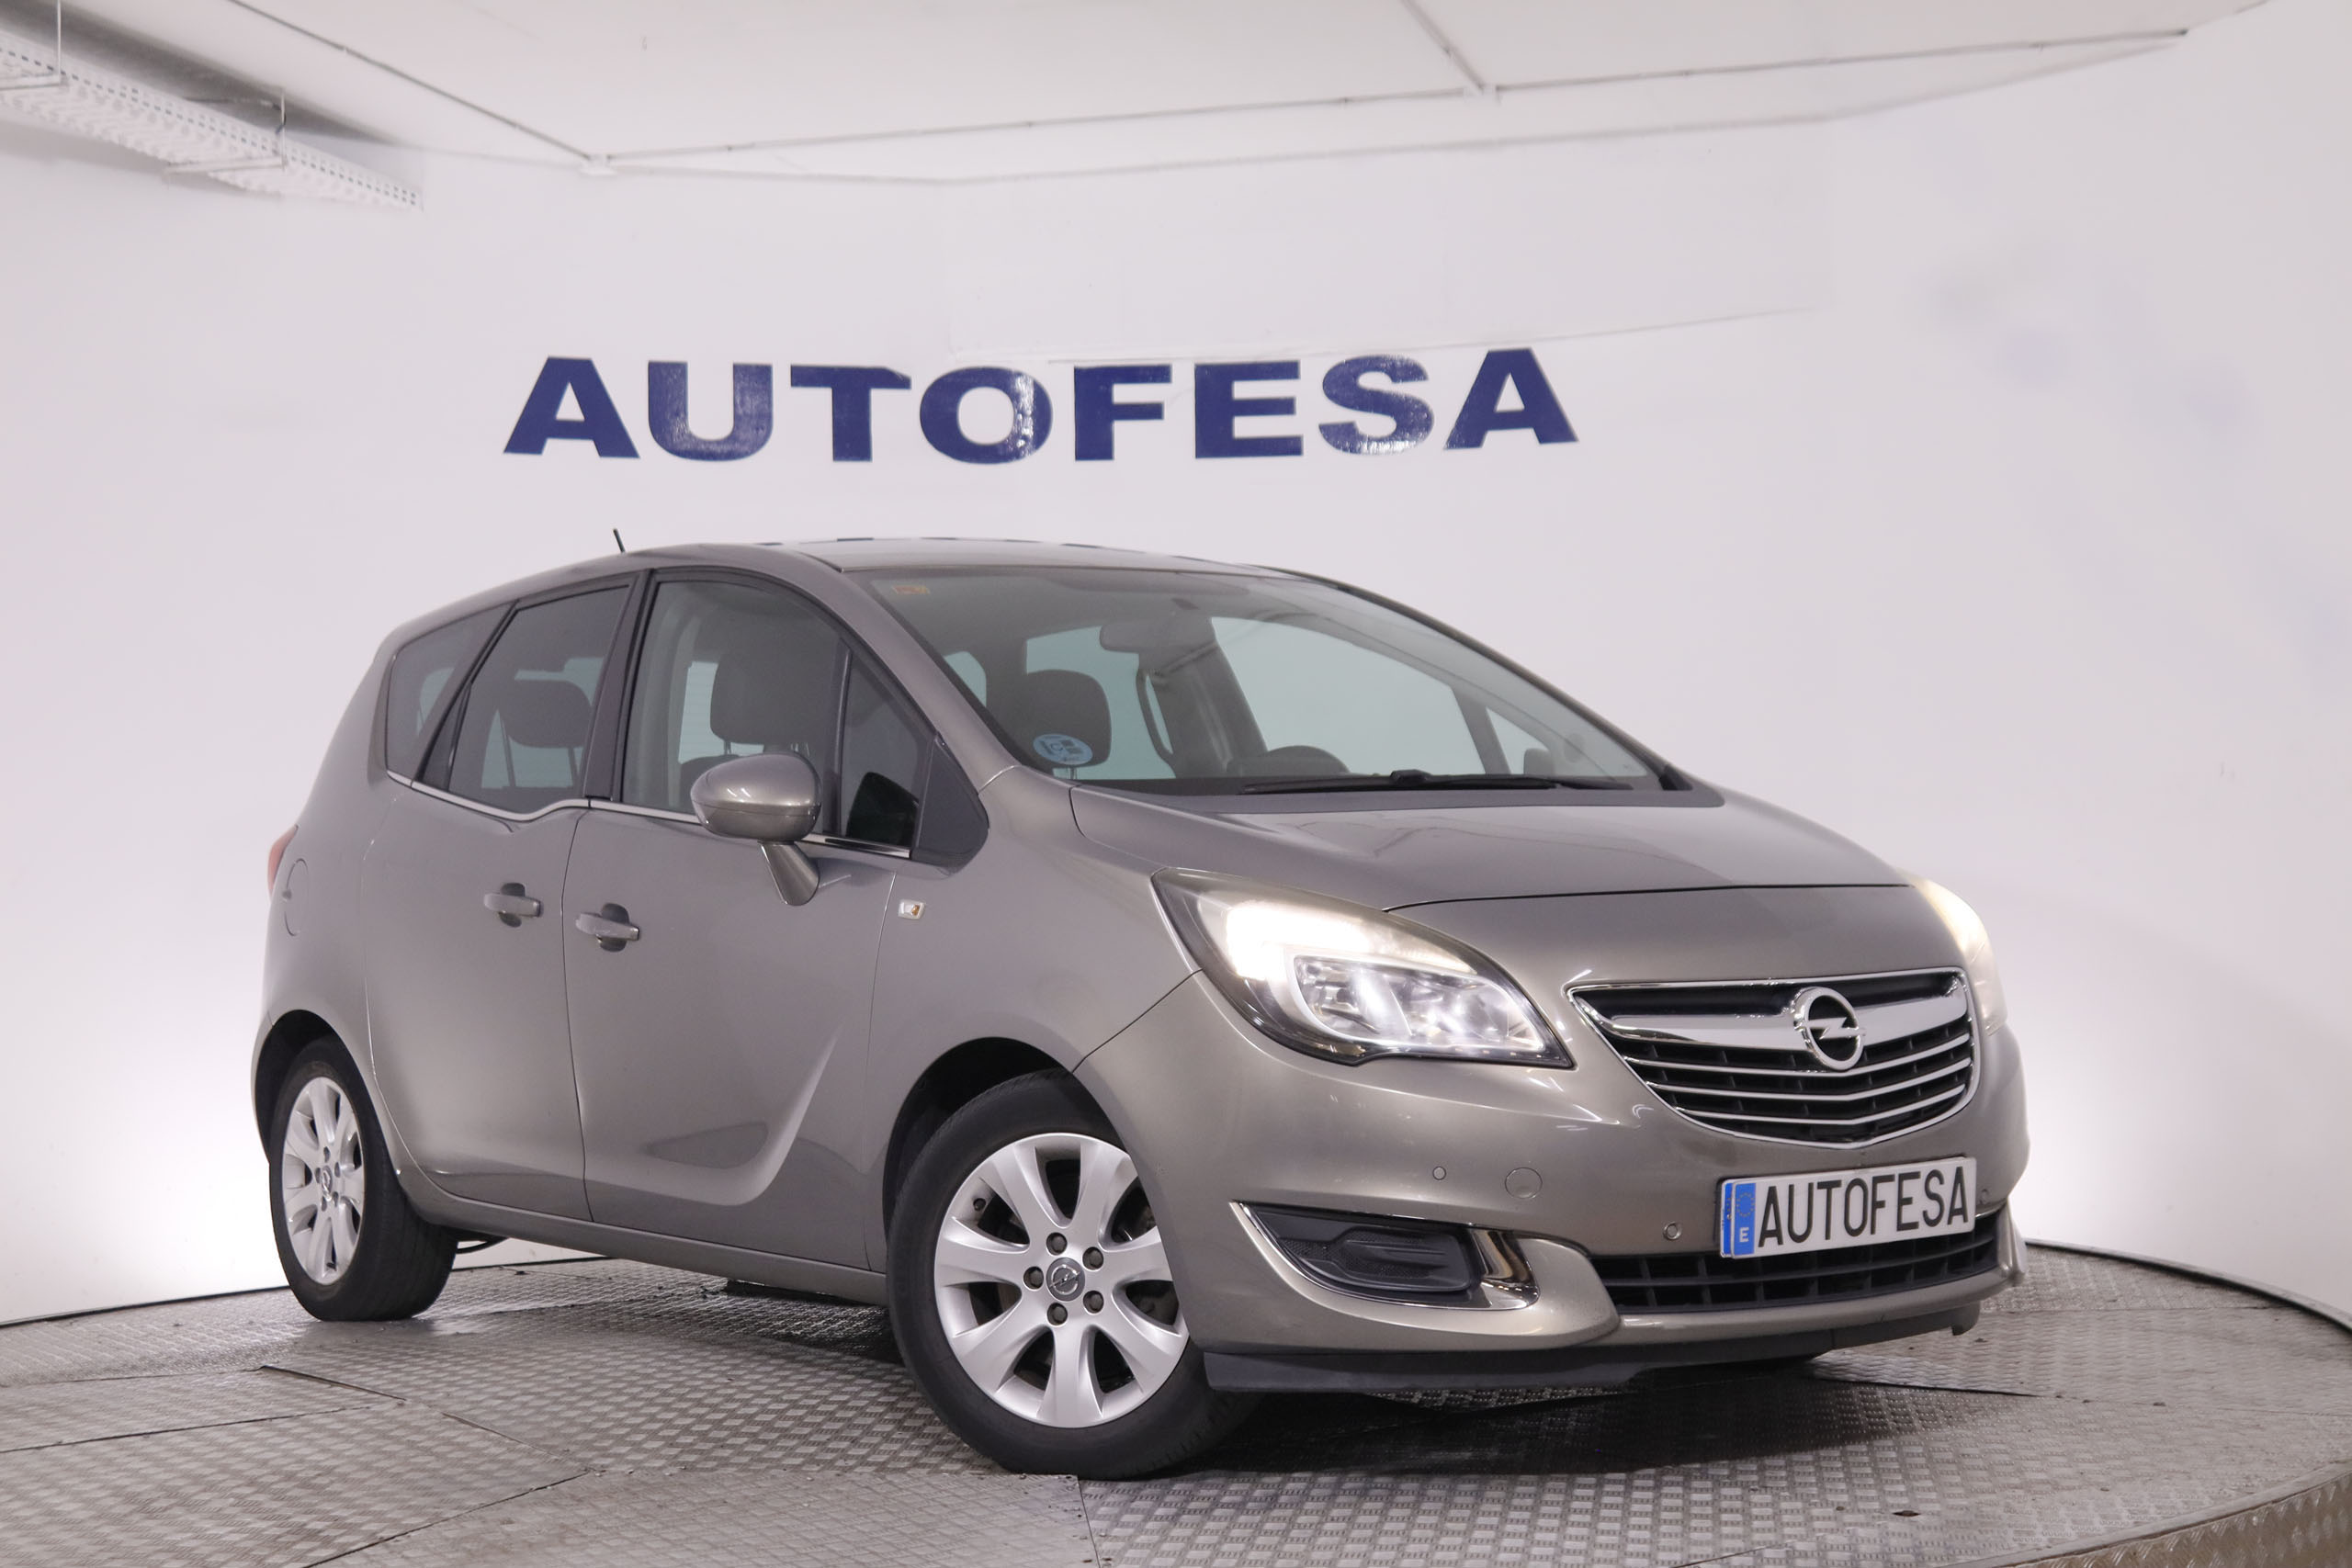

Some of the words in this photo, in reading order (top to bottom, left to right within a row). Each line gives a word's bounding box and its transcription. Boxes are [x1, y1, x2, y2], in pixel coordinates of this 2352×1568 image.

[504, 348, 1578, 464] AUTOFESA
[1739, 1227, 1749, 1242] E
[1758, 1167, 1969, 1247] AUTOFESA
